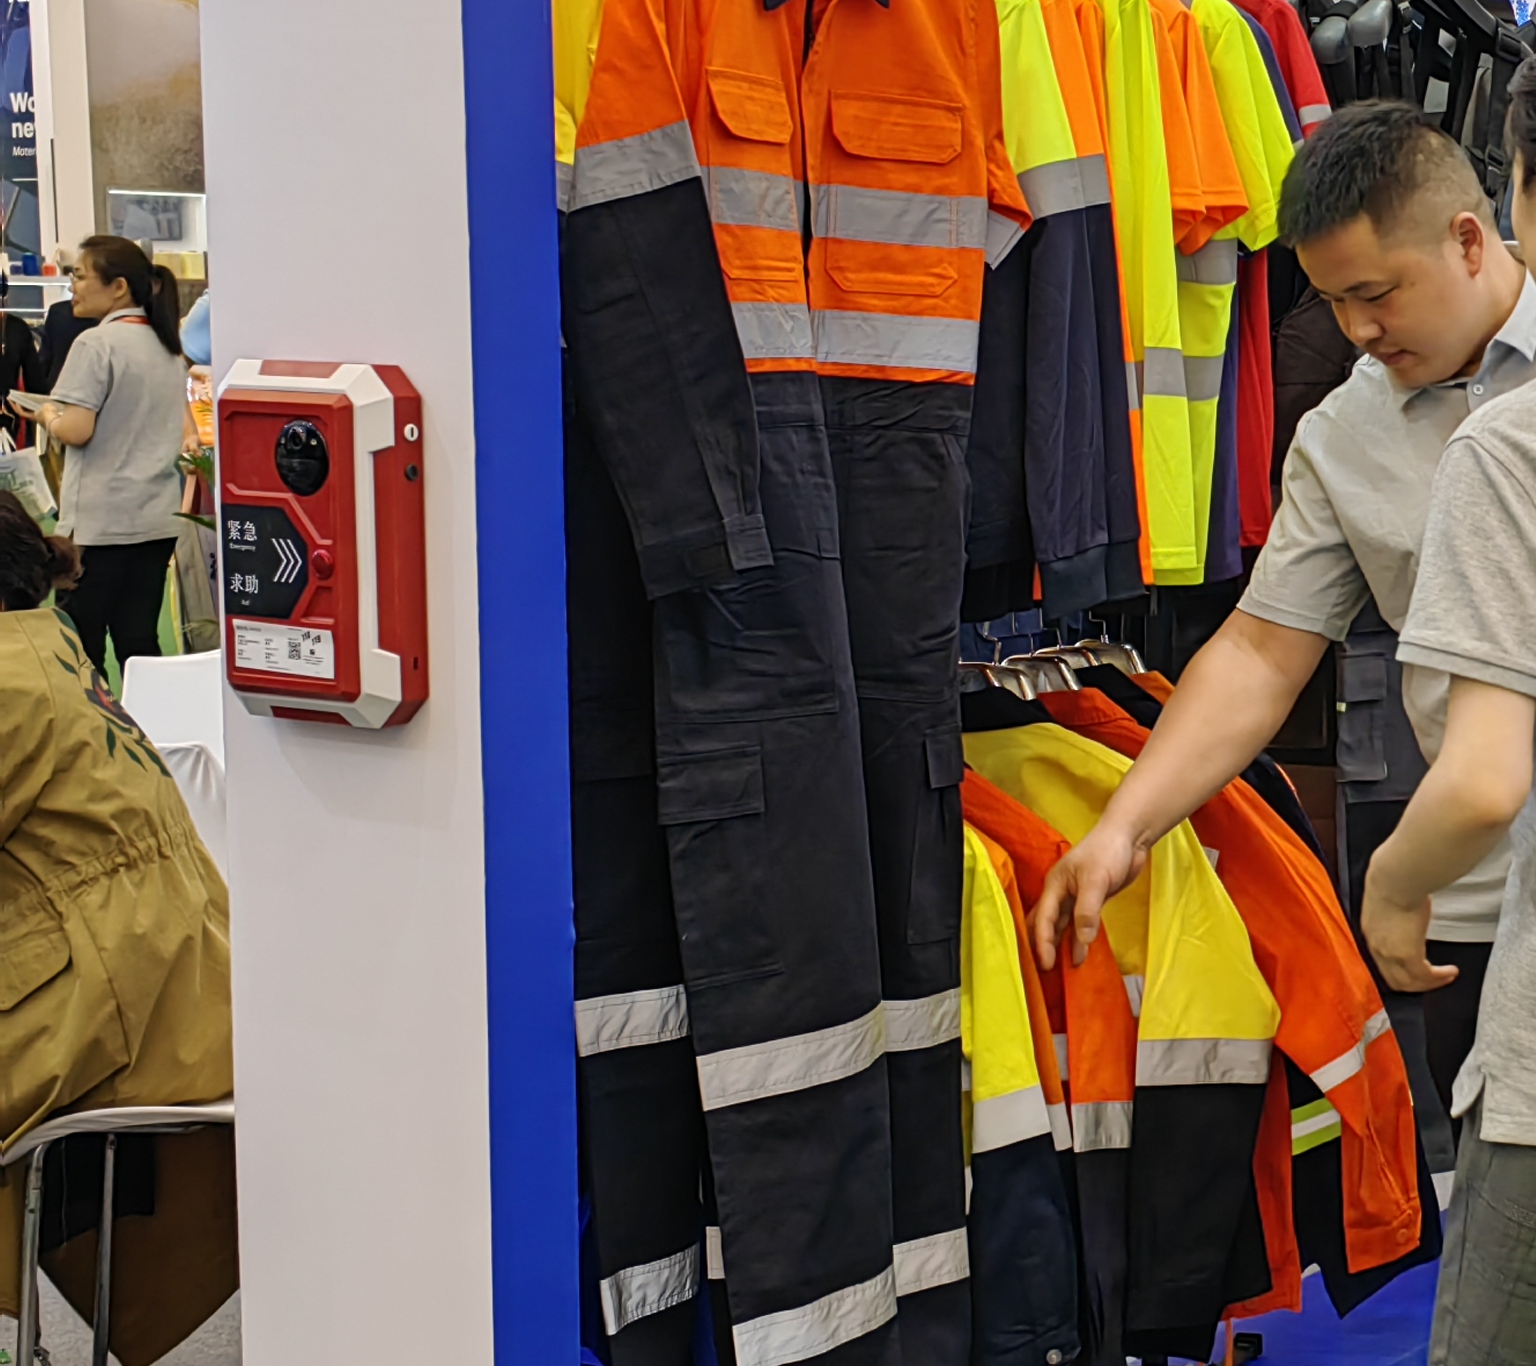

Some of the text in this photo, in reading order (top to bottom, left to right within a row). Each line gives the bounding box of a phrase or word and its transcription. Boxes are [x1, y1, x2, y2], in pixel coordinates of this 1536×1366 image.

[11, 121, 36, 139] ne
[227, 520, 258, 541] 紧急
[230, 573, 259, 595] 求助
